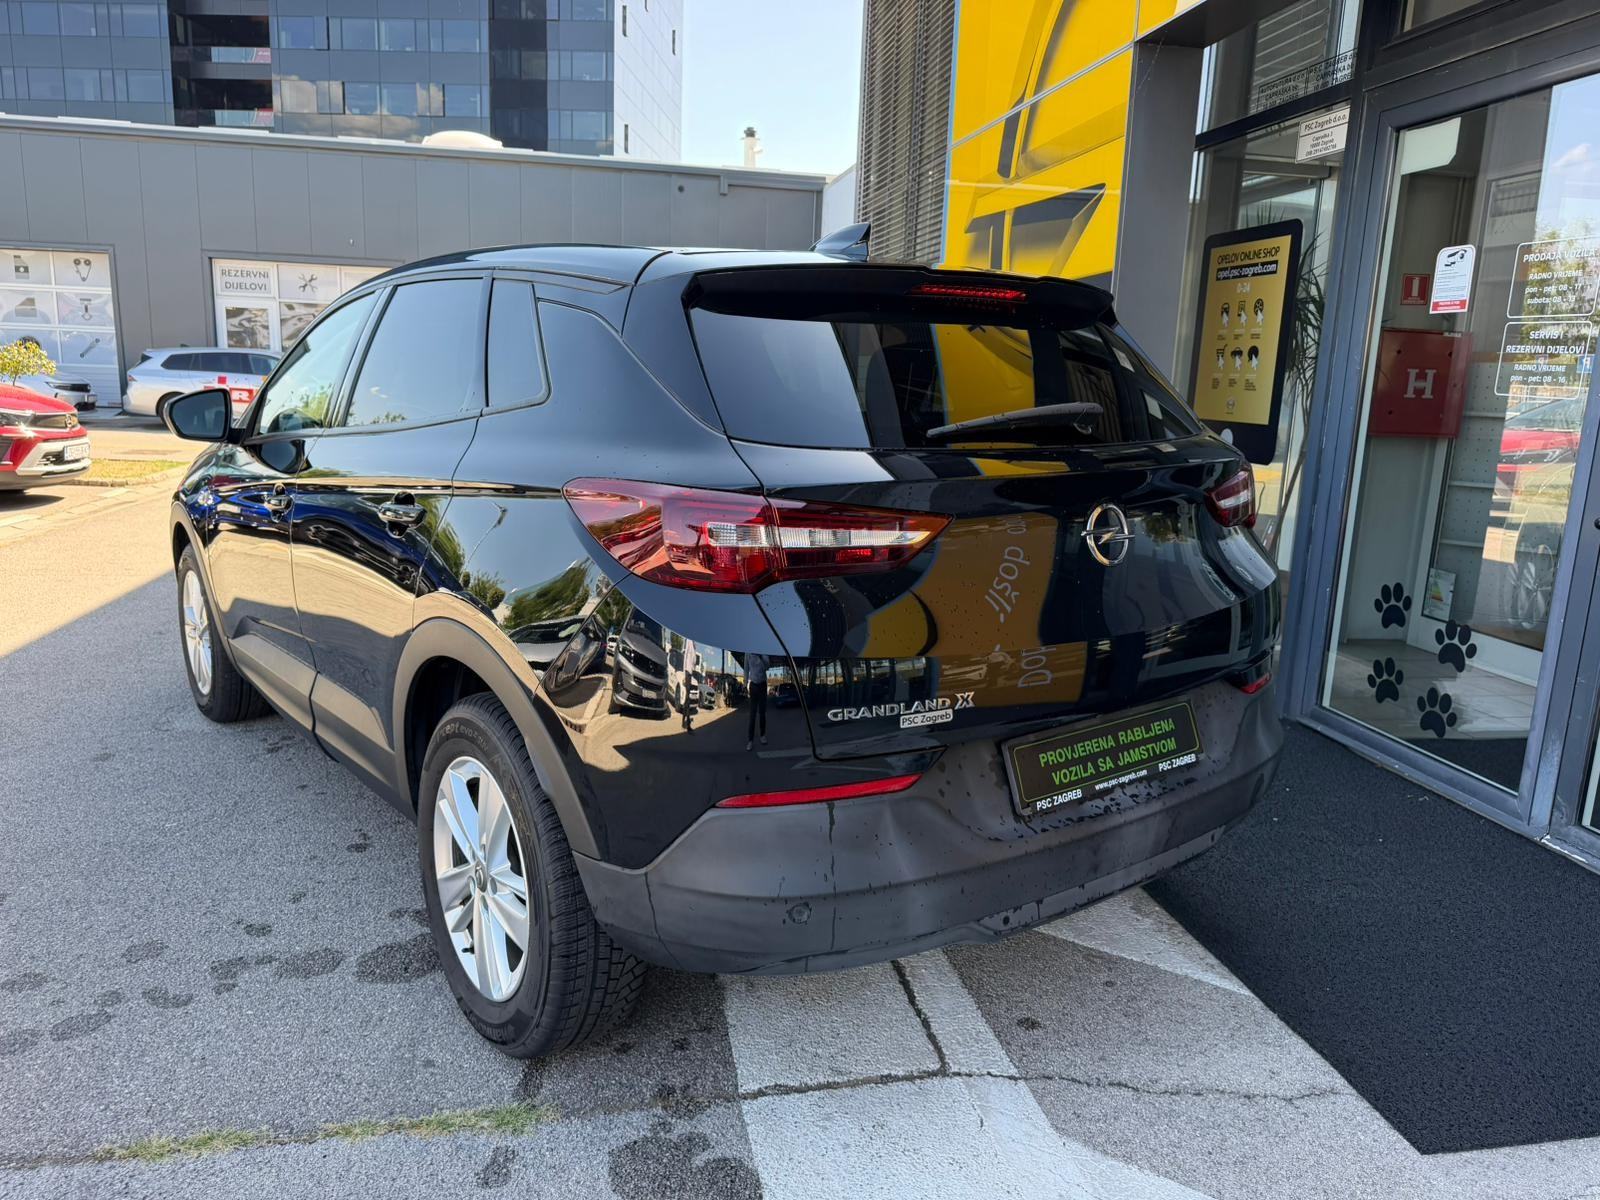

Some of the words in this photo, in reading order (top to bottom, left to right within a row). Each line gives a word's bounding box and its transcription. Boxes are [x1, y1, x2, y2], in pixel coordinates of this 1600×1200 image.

[1304, 122, 1314, 131] PSC
[1314, 116, 1332, 129] Zagreb
[1333, 113, 1347, 123] d.o.o.
[1240, 247, 1263, 262] ONLINE
[1262, 245, 1281, 259] SHOP
[1523, 252, 1561, 263] PRODAJA
[1564, 248, 1595, 258] VOZILA
[221, 268, 269, 279] REZERVNI
[1528, 272, 1553, 280] RADNO
[1553, 269, 1584, 279] VRIJEME
[224, 281, 267, 291] DIJELOVI
[1525, 287, 1538, 295] pon
[1527, 296, 1551, 305] subota:
[1529, 330, 1559, 340] SERVIS
[1506, 345, 1546, 354] REZERVNI
[1546, 345, 1585, 354] DIJELOVI
[1513, 363, 1537, 372] RADNO
[1537, 364, 1567, 373] VRIJEME
[1403, 368, 1437, 399] H
[1510, 375, 1523, 383] pon
[827, 698, 951, 722] GRANDLAND
[954, 691, 976, 710] X
[901, 715, 918, 727] PSC
[920, 711, 951, 726] Zagreb
[1039, 735, 1116, 768] PROVJERENA
[1118, 718, 1176, 746] RABLJENA
[1052, 761, 1096, 786] VOZILA
[1098, 757, 1115, 772] SA
[1117, 737, 1177, 767] JAMSTVOM
[1158, 760, 1172, 772] PSC
[1171, 753, 1197, 768] ZAGREB
[1094, 769, 1148, 791] www.psc-zagreb.com
[1036, 799, 1052, 811] PSC
[1052, 788, 1082, 806] ZAGREB
